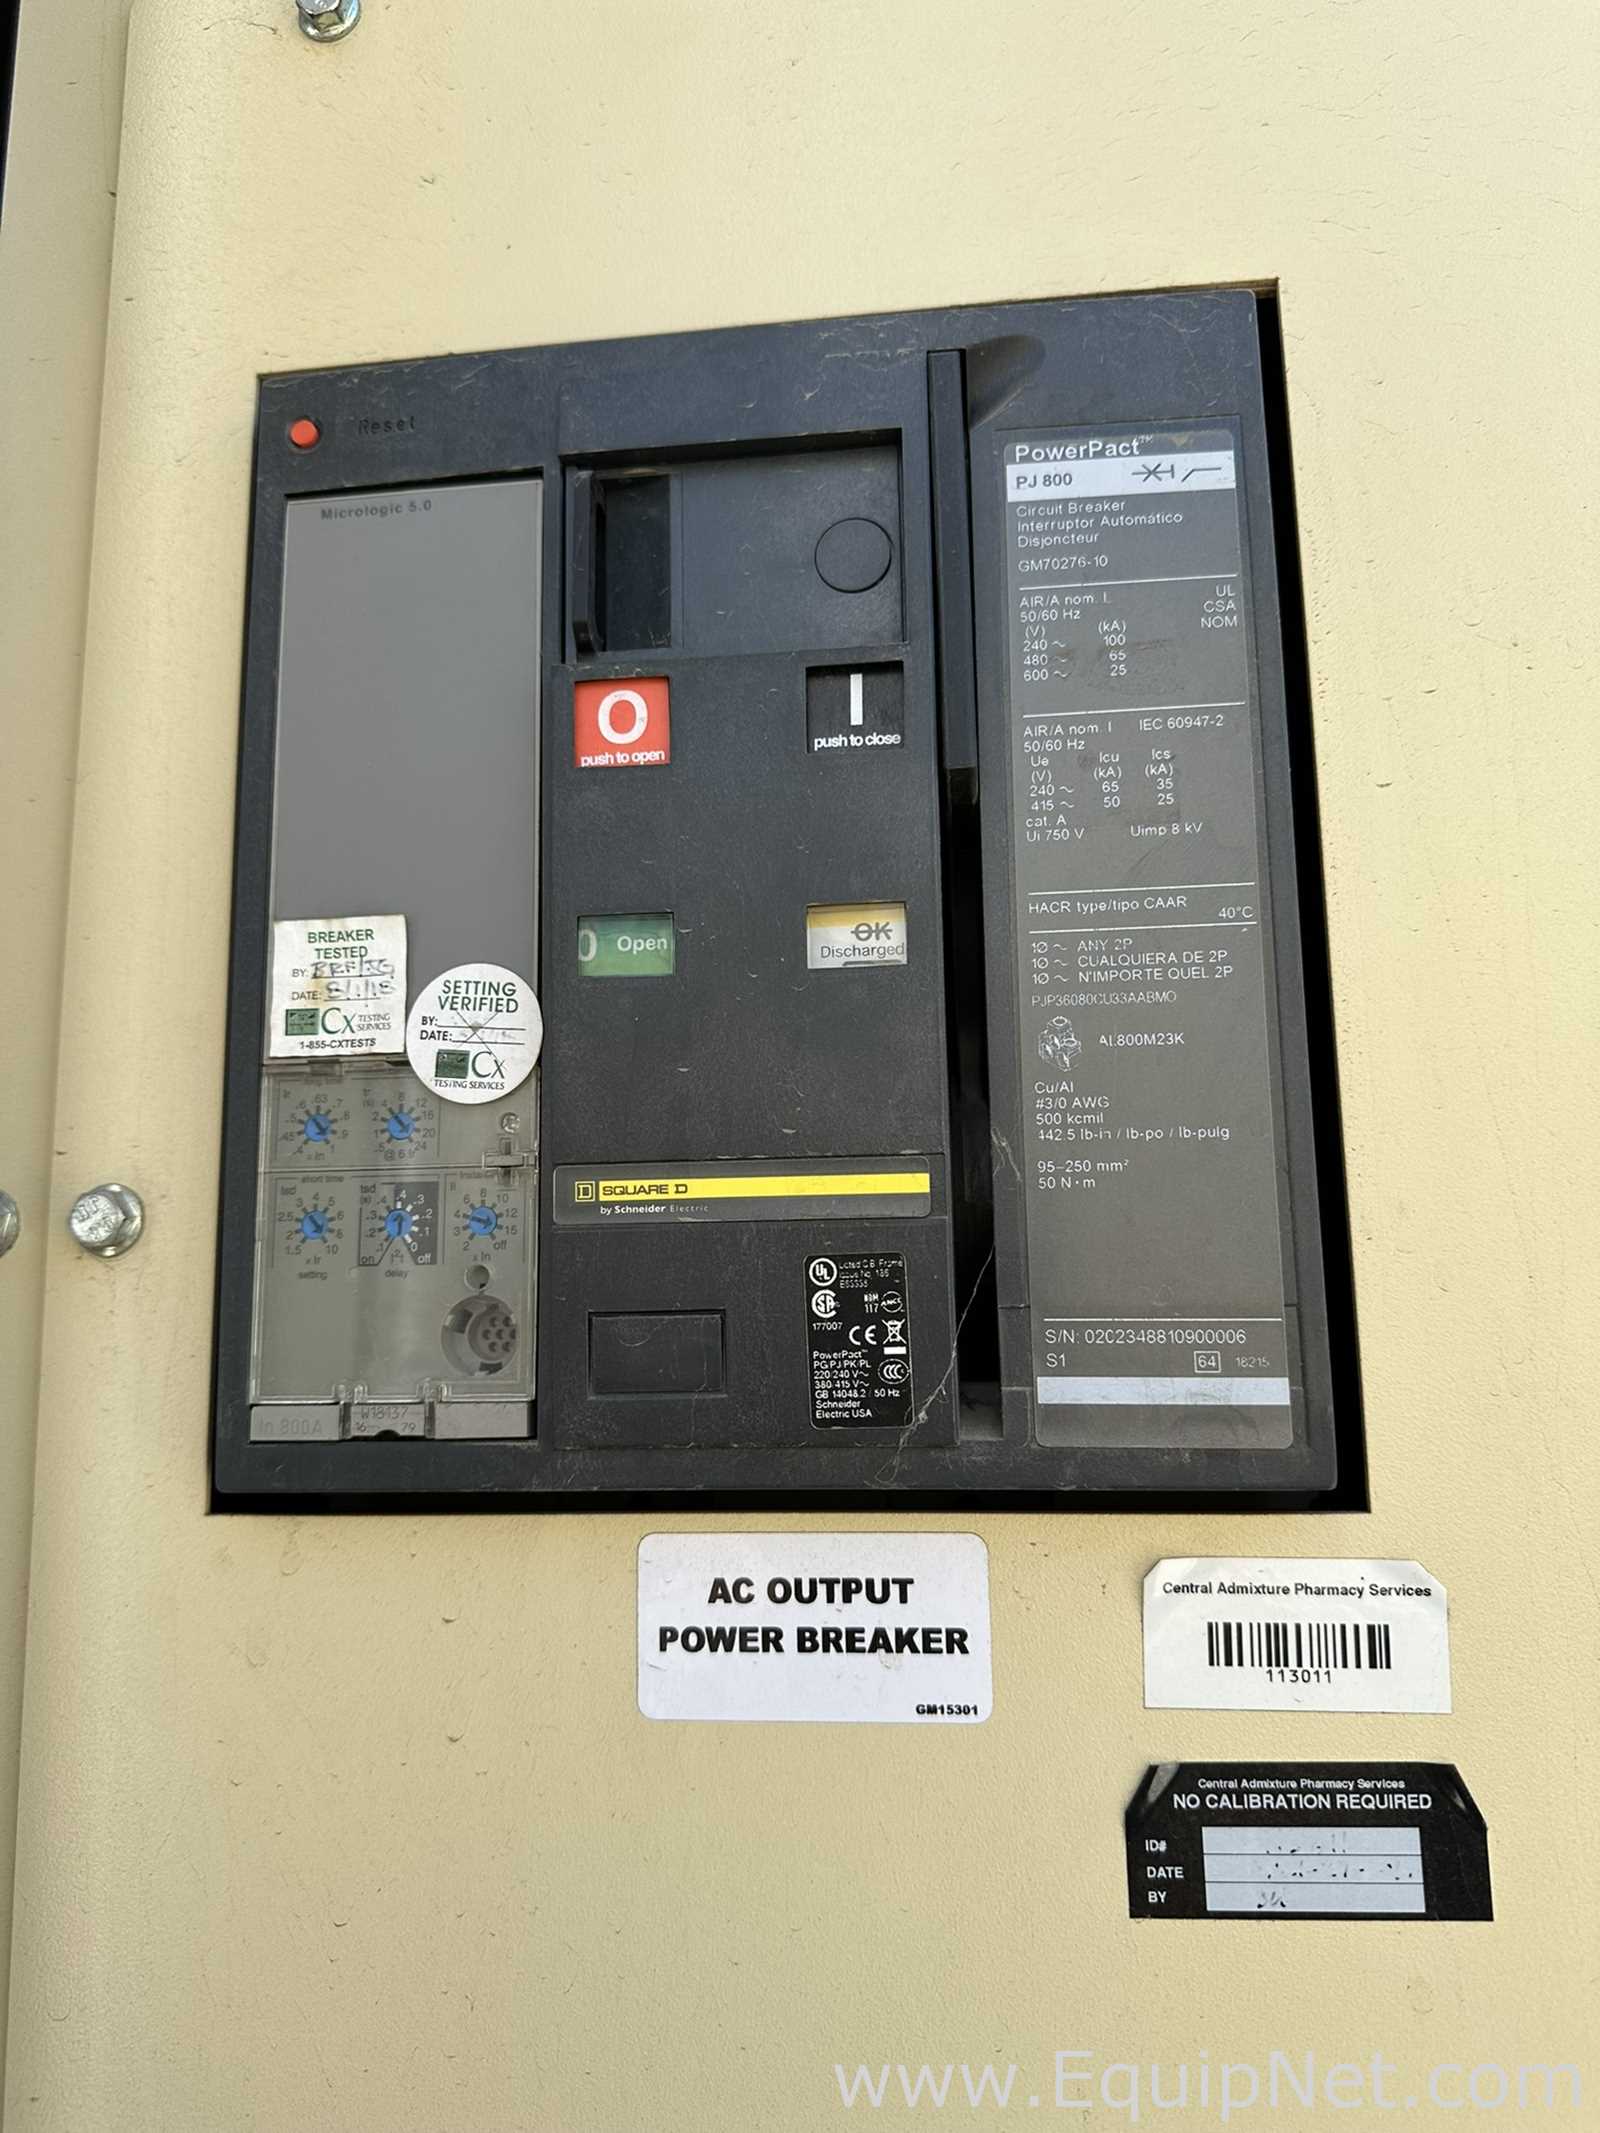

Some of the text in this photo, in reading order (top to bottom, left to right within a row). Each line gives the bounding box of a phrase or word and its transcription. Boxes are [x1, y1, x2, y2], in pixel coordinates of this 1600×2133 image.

[358, 414, 416, 436] Reset
[1016, 473, 1073, 489] PJ 800
[320, 499, 432, 521] Micrologic 5.0
[1016, 500, 1125, 517] Circuit Breaker
[1018, 517, 1094, 533] Interruptor
[1017, 532, 1099, 549] Disjoncteur
[1018, 555, 1108, 572] GM70276-10
[1216, 585, 1235, 597] UL
[1020, 593, 1060, 608] AIR/A
[1203, 600, 1236, 613] CSA
[1020, 608, 1080, 622] 50/60 Hz
[1201, 616, 1238, 628] NOM
[1025, 620, 1126, 639] (V) (kA)
[1023, 634, 1126, 651] 240 100
[1023, 650, 1126, 666] 480 65
[1023, 665, 1127, 681] 600 25
[1139, 715, 1224, 731] IEC 60947-2
[1023, 725, 1065, 738] AIR/A
[814, 732, 901, 751] push to close
[1023, 738, 1085, 752] 50/60 Hz
[581, 749, 666, 768] push to open
[1030, 756, 1049, 767] Ue
[1031, 763, 1174, 784] (V) (kA) (kA)
[1029, 779, 1174, 797] 240 65 35
[1031, 794, 1174, 811] 415 50 25
[1025, 814, 1066, 828] cat. A
[1026, 828, 1085, 842] Ui 750 V
[1130, 822, 1203, 838] Uimp 8 kV
[1028, 896, 1254, 919] HACR type/tipo CAAR 40°C
[308, 929, 374, 944] BREAKER
[617, 935, 668, 955] Open
[1077, 938, 1133, 952] ANY 2P
[315, 946, 368, 960] TESTED
[820, 943, 905, 963] Discharged
[1078, 950, 1228, 968] CUALQUIERA DE 2P
[292, 967, 308, 978] BY:
[1078, 965, 1233, 984] N'IMPORTE QUEL 2P
[442, 979, 517, 996] SETTING
[292, 990, 321, 1001] DATE:
[438, 996, 519, 1013] VERIFIED
[358, 1013, 391, 1024] TESTING
[421, 1016, 438, 1026] BY:
[356, 1022, 392, 1032] SERVICES
[300, 1037, 377, 1050] 1-855-CXTESTS
[420, 1030, 452, 1042] DATE:
[433, 1078, 505, 1091] TESTING SERVICES
[1035, 1095, 1110, 1110] #3/0 AWG
[1036, 1112, 1103, 1125] 500 kcmil
[1179, 1125, 1230, 1141] lb-pulg
[602, 1183, 688, 1196] SQUARE D
[1038, 1177, 1055, 1189] 50
[600, 1204, 709, 1216] by Schneider Electric
[361, 1253, 431, 1265] on off
[812, 1322, 843, 1331] 177007
[1045, 1329, 1080, 1344] S/N:
[1046, 1353, 1066, 1368] S1
[1198, 1355, 1216, 1368] 64
[815, 1390, 829, 1399] GB
[874, 1388, 886, 1398] 50
[888, 1388, 901, 1397] Hz
[815, 1400, 861, 1409] Schneider
[815, 1409, 873, 1419] Electric USA
[708, 1577, 914, 1604] AC OUTPUT
[1163, 1582, 1431, 1599] Central Admixture Pharmacy Services
[659, 1626, 969, 1655] POWER BREAKER
[1266, 1669, 1331, 1684] 113011
[916, 1704, 978, 1716] GM15301
[1198, 1778, 1405, 1792] Central Admixture Pharmacy Services
[1173, 1793, 1432, 1810] NO CALIBRATION REQUIRED
[1145, 1840, 1167, 1852] ID#
[1147, 1867, 1184, 1878] DATE
[1148, 1891, 1167, 1903] BY
